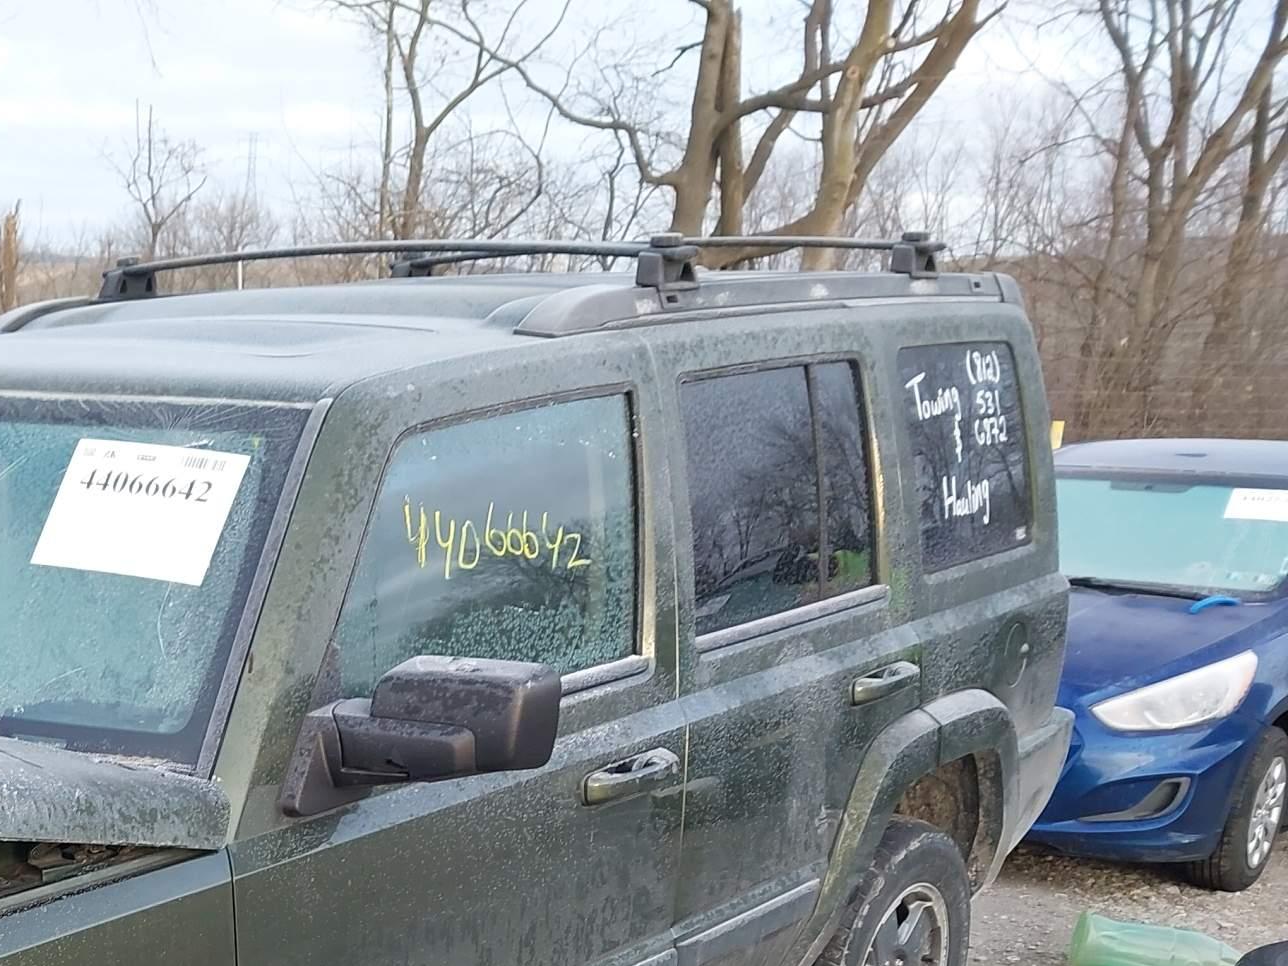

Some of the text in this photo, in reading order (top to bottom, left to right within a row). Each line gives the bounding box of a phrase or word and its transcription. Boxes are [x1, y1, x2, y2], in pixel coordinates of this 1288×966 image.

[965, 350, 1001, 385] (812)
[905, 372, 962, 421] Towing
[975, 389, 1001, 416] 531
[80, 468, 213, 503] 44066642
[942, 476, 991, 525] Hauling
[403, 495, 593, 580] 44066642
